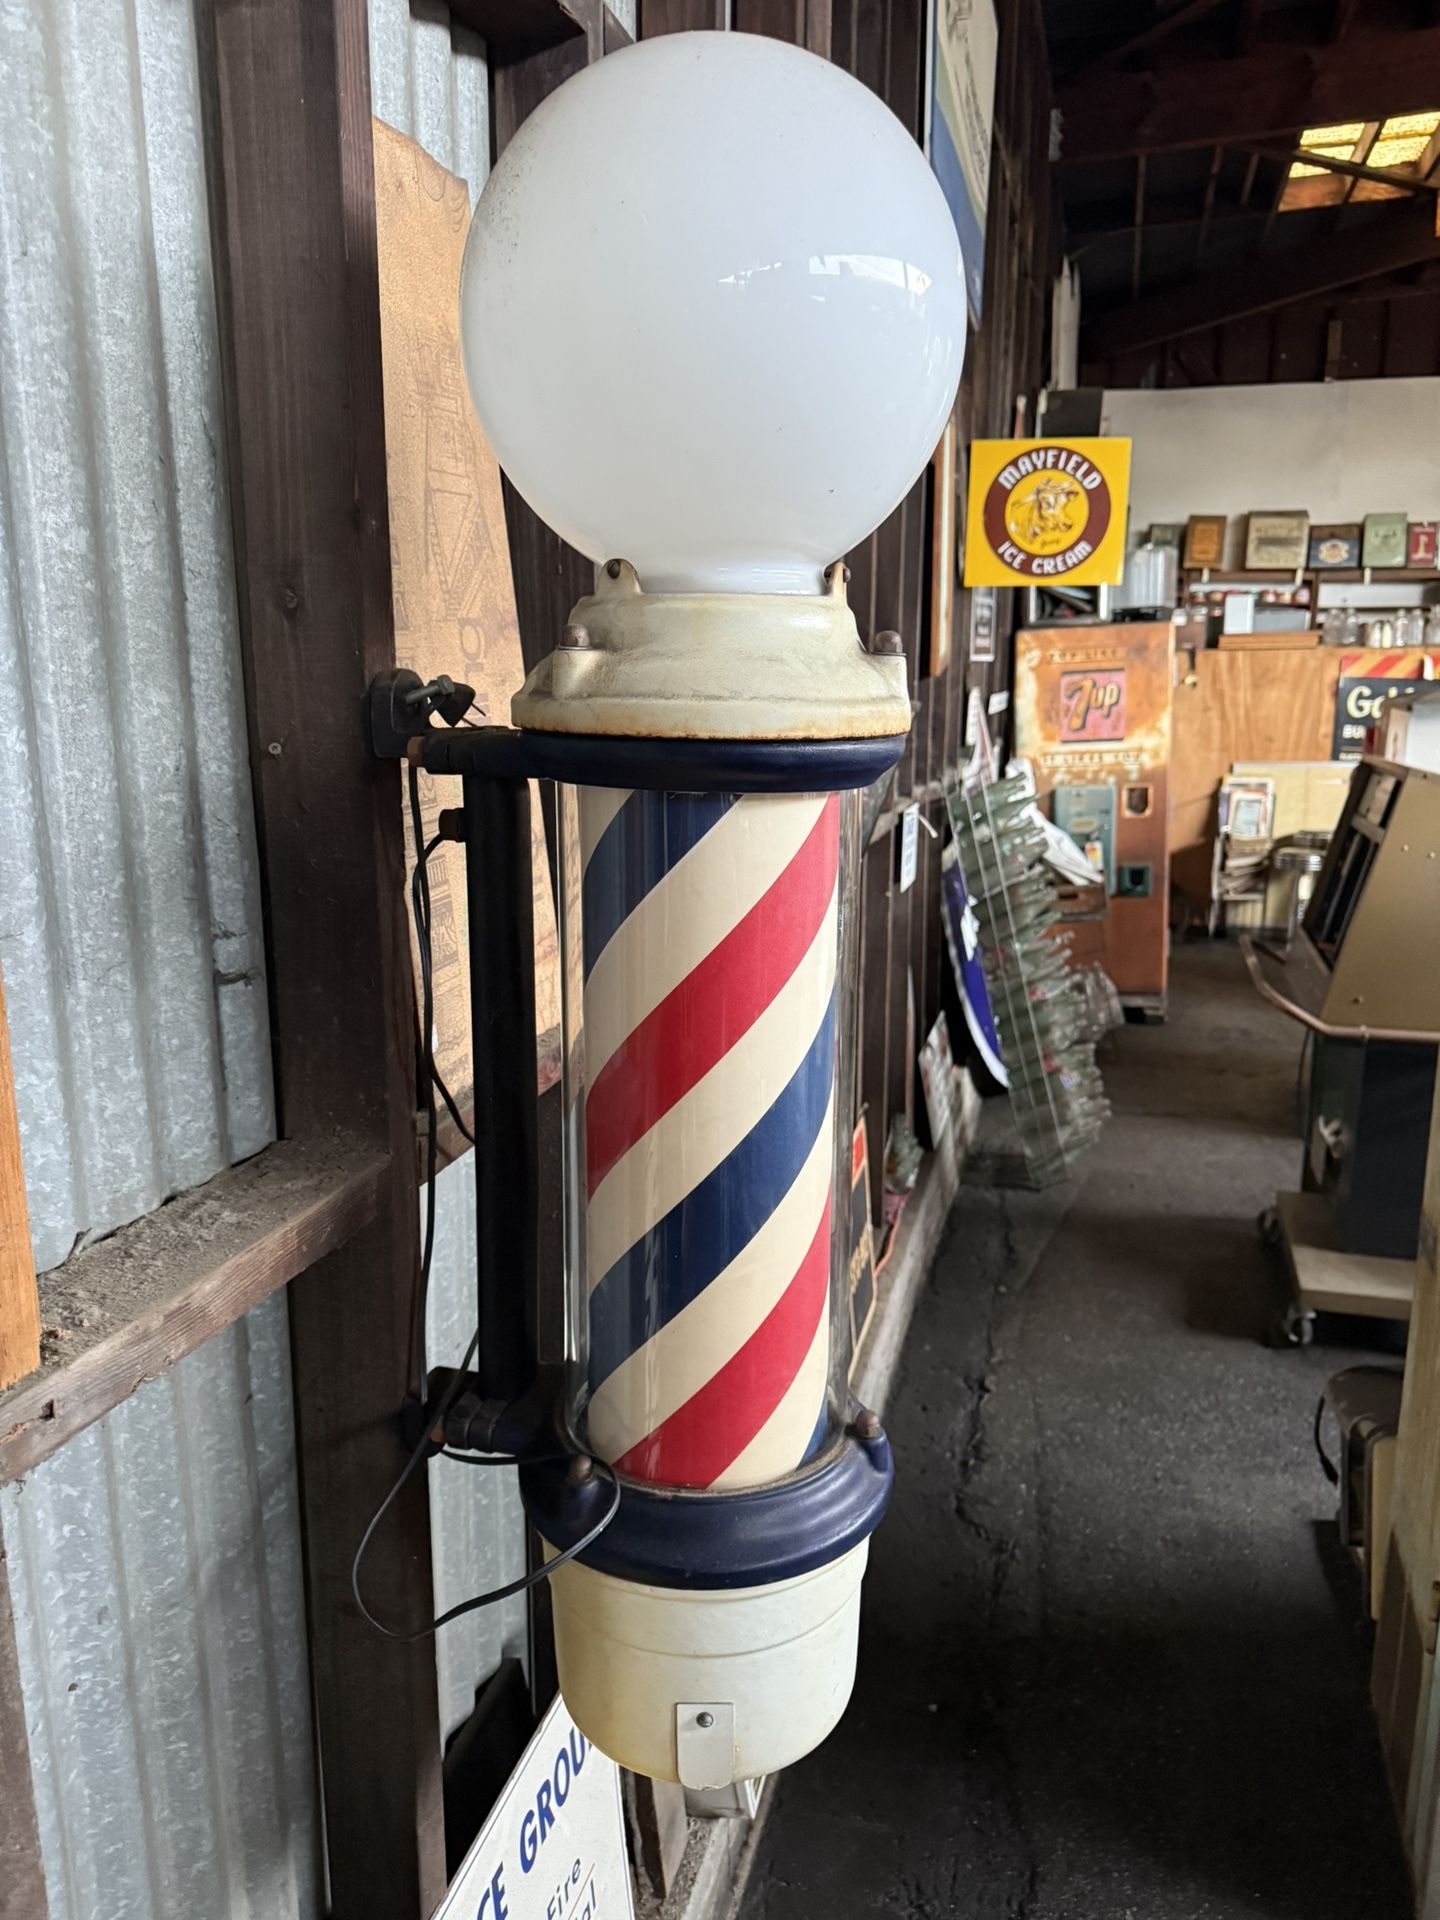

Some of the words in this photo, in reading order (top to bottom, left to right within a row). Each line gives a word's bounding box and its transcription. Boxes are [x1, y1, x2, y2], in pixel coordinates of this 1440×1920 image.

[997, 449, 1103, 490] MAYFIELD
[997, 540, 1027, 570] ICE
[1031, 540, 1094, 575] CREAM
[519, 1727, 592, 1873] GROU
[547, 1858, 581, 1920] Fire
